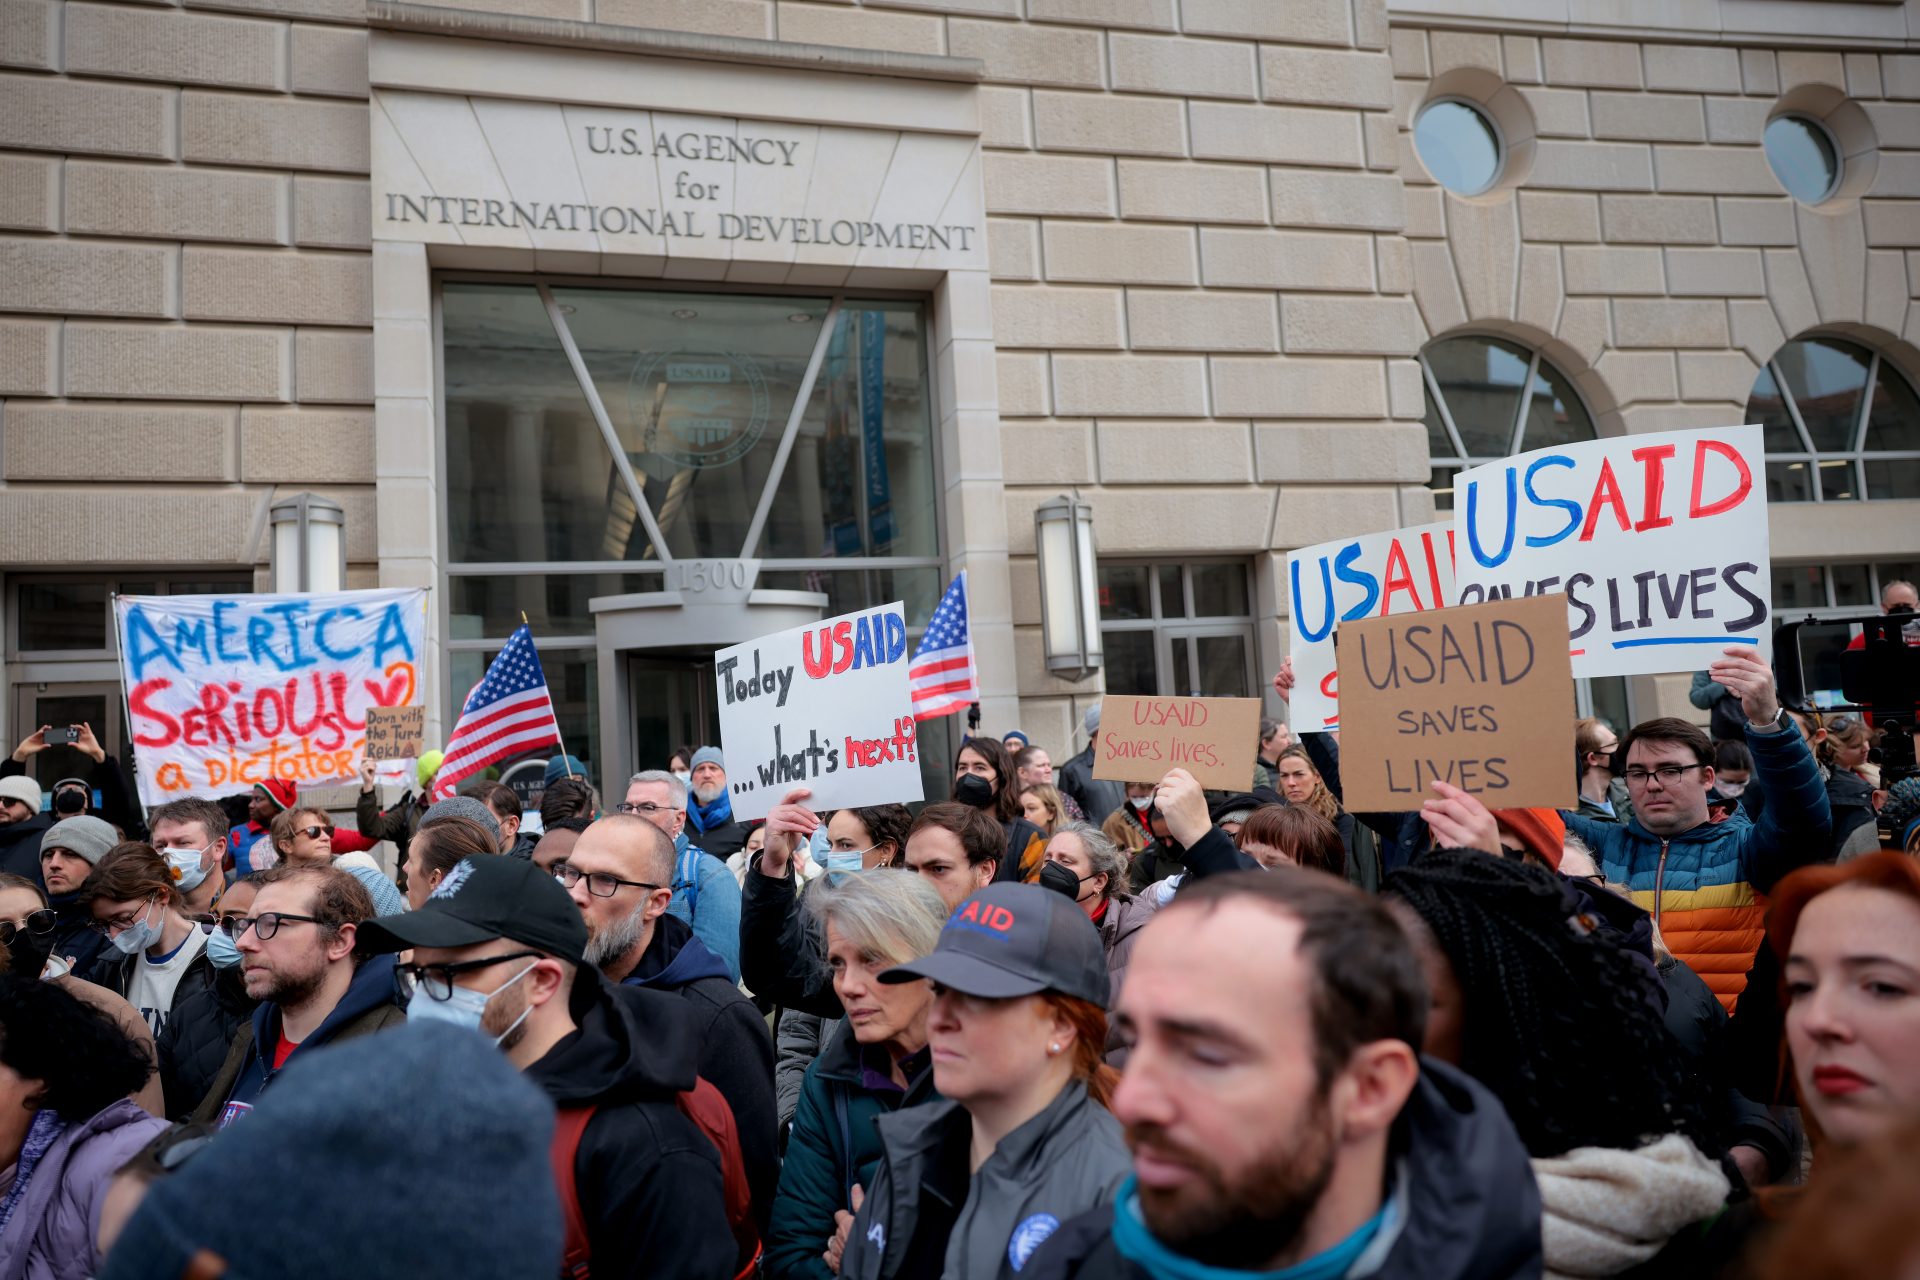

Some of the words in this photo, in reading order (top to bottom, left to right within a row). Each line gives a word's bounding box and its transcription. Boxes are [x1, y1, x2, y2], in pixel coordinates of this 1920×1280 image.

[585, 126, 643, 156] U.S.
[651, 131, 799, 167] AGENCY
[675, 171, 720, 201] for
[385, 193, 705, 238] INTERNATIONAL
[718, 213, 975, 251] DEVELOPMENT
[671, 367, 727, 379] USAID
[1466, 439, 1752, 569] USAID
[678, 561, 745, 593] 1300
[1290, 530, 1456, 643] USAI
[1606, 561, 1767, 633] LIVES
[127, 601, 414, 681] AMERICA
[1359, 619, 1535, 690] USAID
[717, 648, 794, 707] Today
[802, 612, 906, 680] USAID
[367, 710, 396, 725] Down
[401, 707, 423, 723] with
[1133, 700, 1209, 727] USAID
[1397, 704, 1498, 736] SAVES
[366, 725, 387, 740] the
[845, 715, 916, 769] next?
[1105, 732, 1163, 761] Saves
[367, 741, 400, 759] Reich
[155, 761, 192, 791] a
[1385, 757, 1510, 793] LIVES
